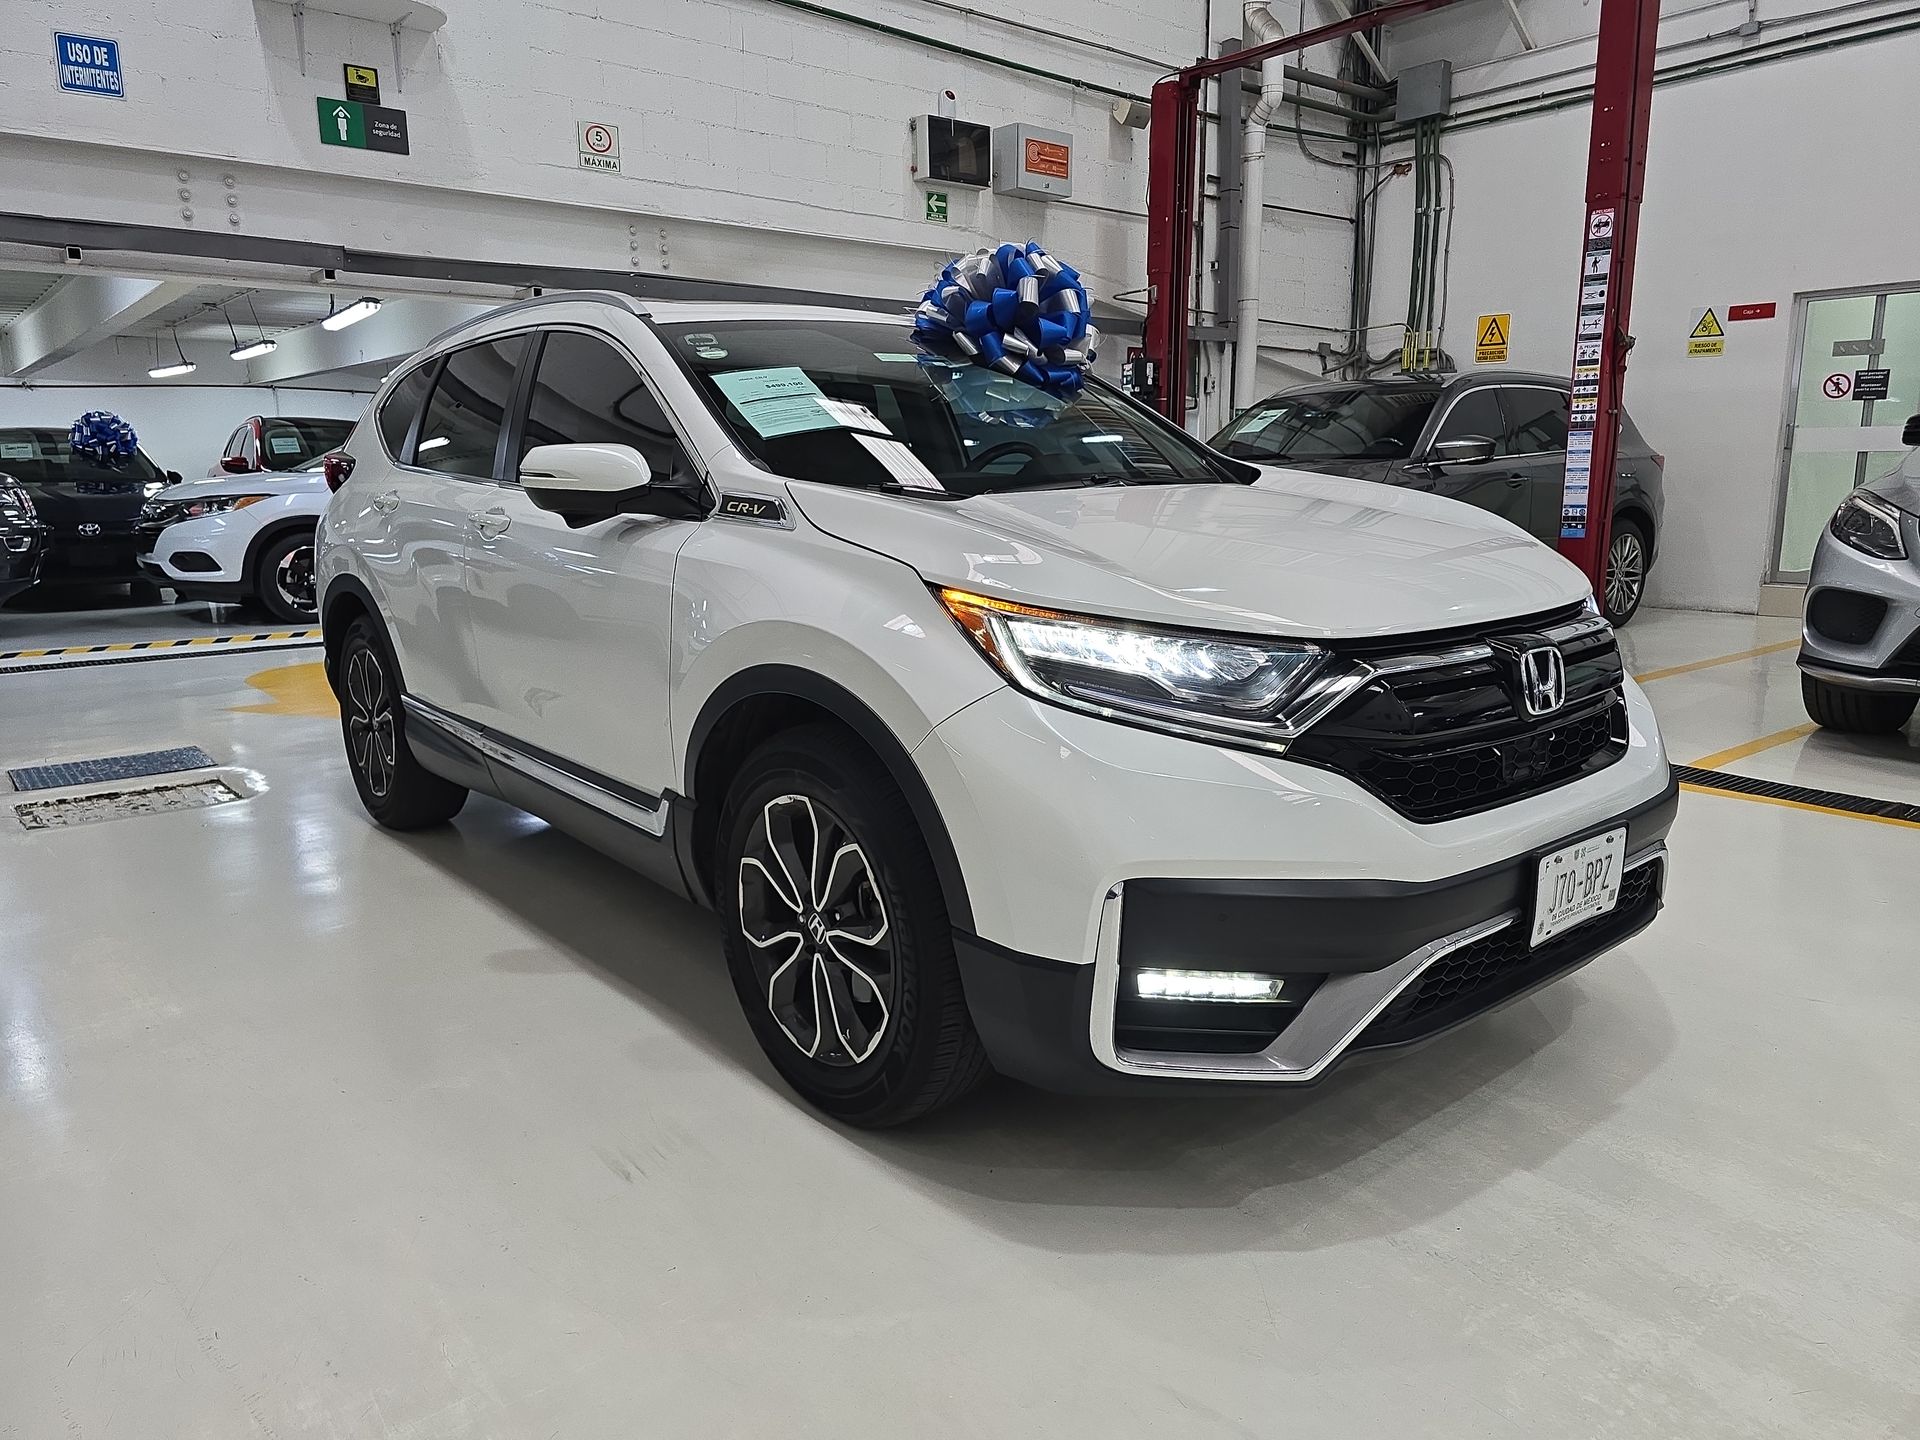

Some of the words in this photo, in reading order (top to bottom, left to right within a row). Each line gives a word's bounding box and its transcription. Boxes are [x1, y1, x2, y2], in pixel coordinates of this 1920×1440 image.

[67, 41, 91, 64] USO
[93, 45, 110, 67] DE
[62, 63, 120, 91] INTERMITENTES
[374, 121, 389, 129] Zona
[373, 129, 401, 139] seguridad
[595, 130, 603, 142] 5
[726, 501, 767, 515] CR-V
[1548, 854, 1613, 914] J70-BPZ
